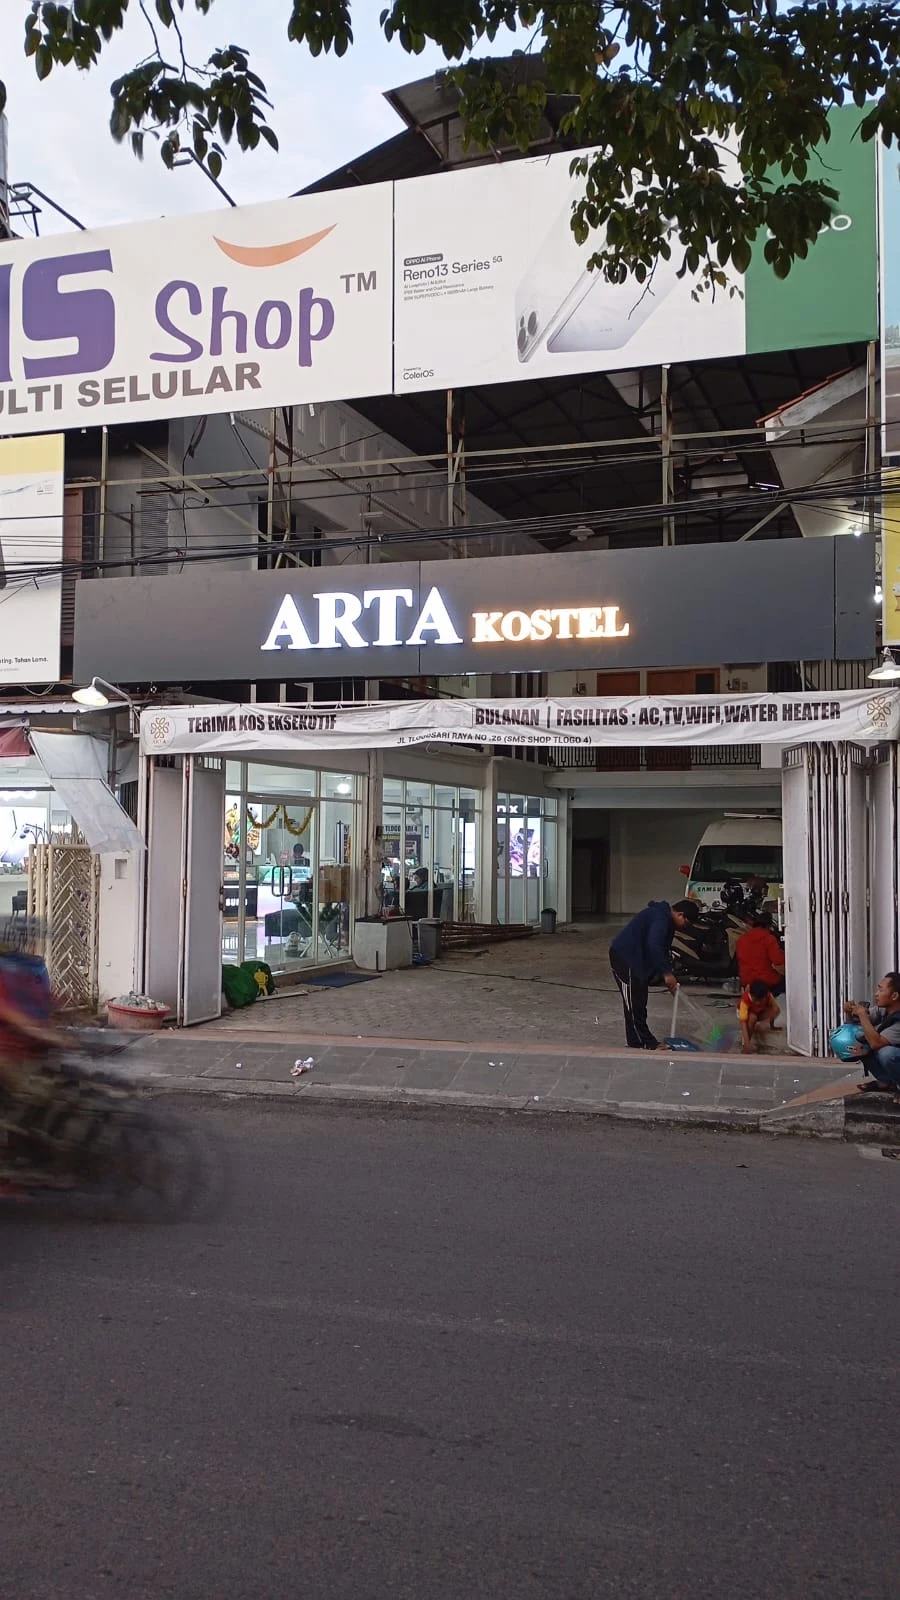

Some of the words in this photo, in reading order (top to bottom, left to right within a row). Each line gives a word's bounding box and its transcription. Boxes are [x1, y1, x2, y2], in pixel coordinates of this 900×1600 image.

[403, 264, 448, 282] Reno13
[452, 259, 490, 274] Series
[149, 279, 335, 367] Shop
[340, 270, 377, 294] TM
[77, 361, 262, 408] SELULAR
[403, 369, 434, 380] ColorOS
[260, 586, 463, 650] ARTA
[472, 606, 630, 643] KOSTEL
[188, 715, 236, 733] TERIMA
[239, 714, 265, 732] KOS
[268, 714, 337, 731] EKSEKUTIF
[475, 708, 540, 726] BULANAN
[556, 708, 628, 726] FASILITAS
[782, 702, 841, 722] HEATER
[452, 732, 473, 740] RAYA
[503, 735, 525, 744] (SMS
[527, 736, 551, 744] SHOP
[553, 736, 581, 744] TLOGO
[582, 735, 592, 745] 4)
